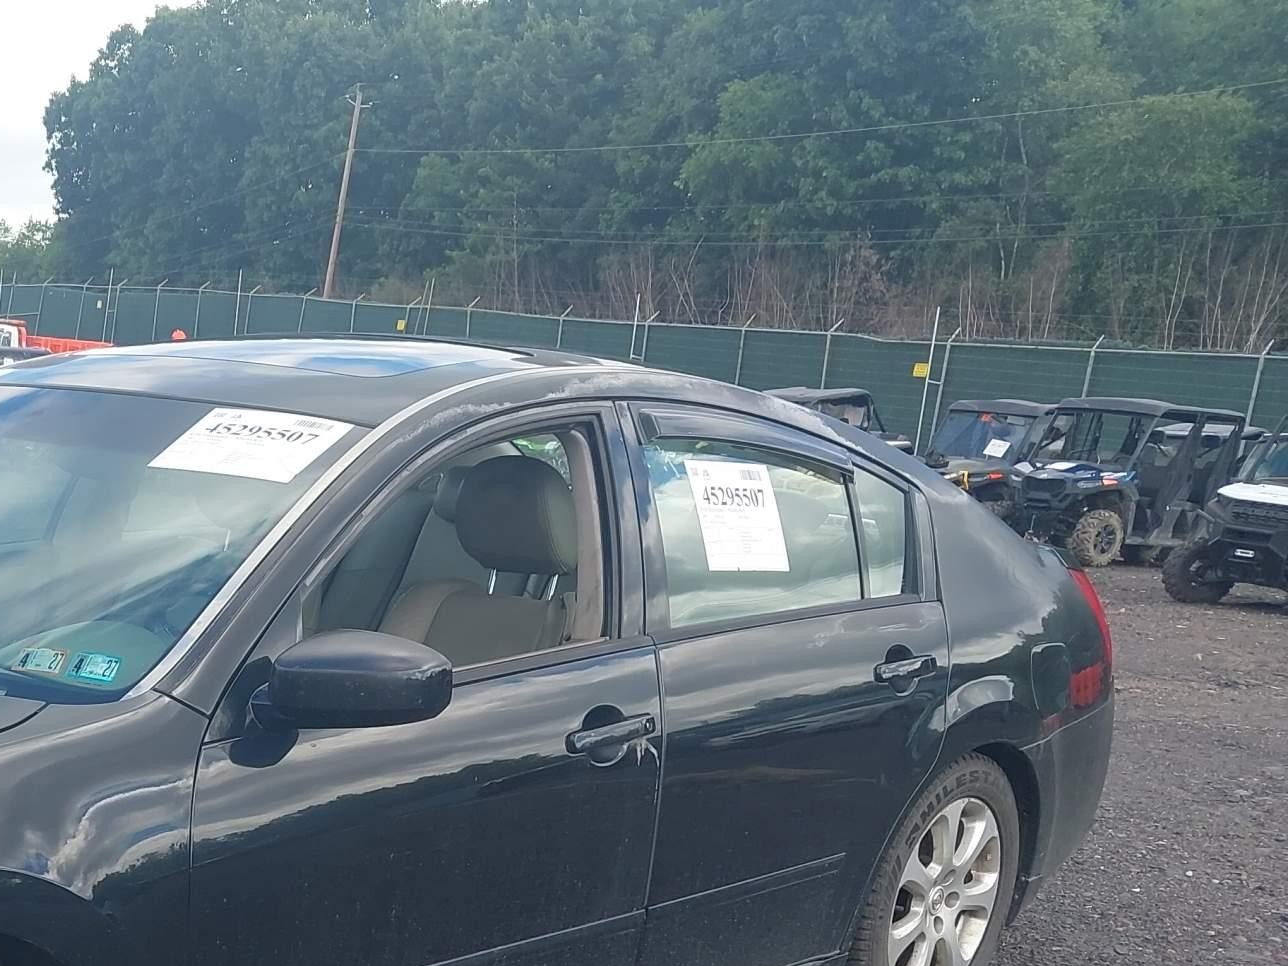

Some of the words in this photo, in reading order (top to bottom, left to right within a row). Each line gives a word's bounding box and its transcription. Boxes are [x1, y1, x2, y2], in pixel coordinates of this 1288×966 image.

[205, 422, 320, 444] 45295507
[703, 485, 765, 509] 45295507
[47, 652, 65, 672] 27
[102, 659, 119, 679] 27
